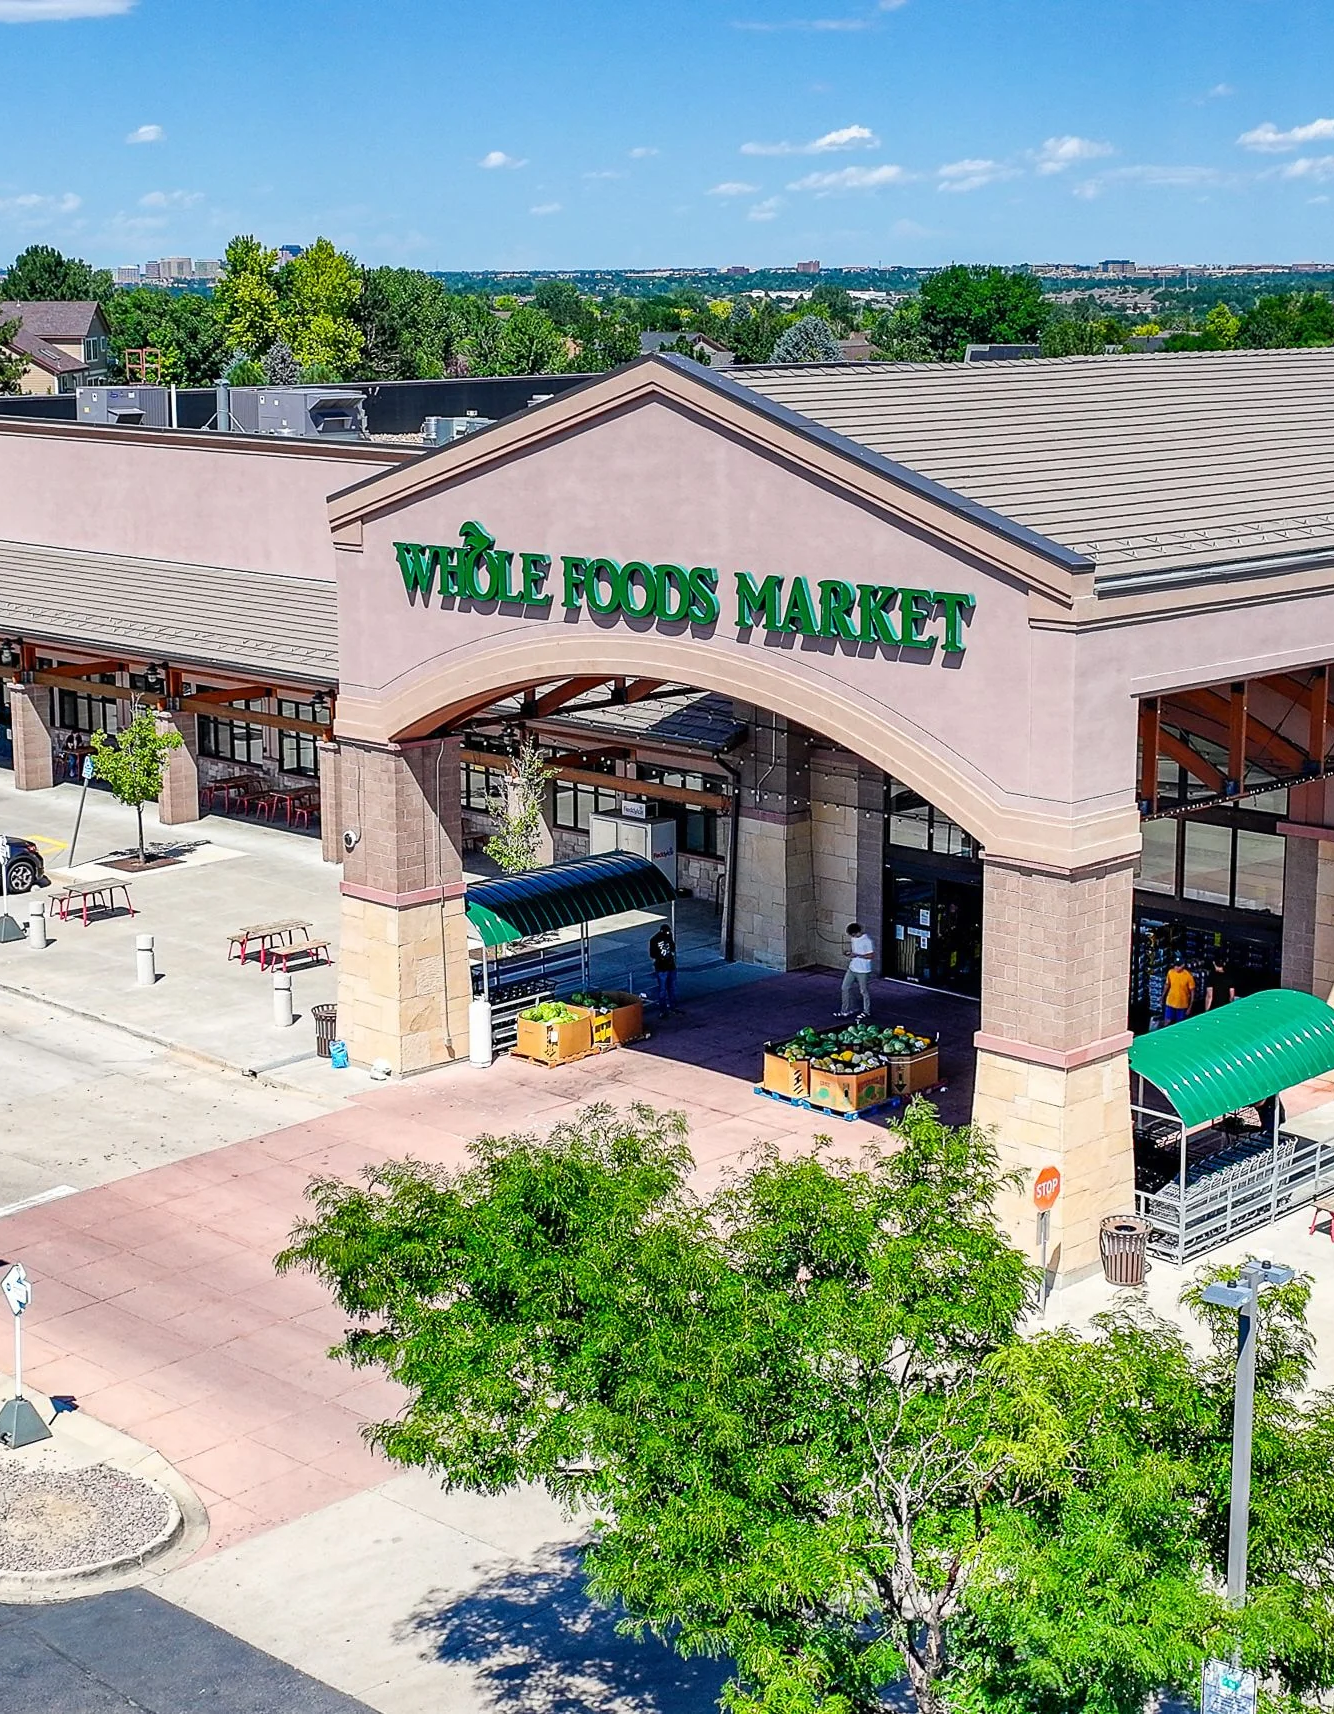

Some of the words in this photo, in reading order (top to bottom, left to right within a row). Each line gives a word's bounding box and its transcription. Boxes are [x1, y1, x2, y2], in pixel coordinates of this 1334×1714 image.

[392, 521, 553, 606] WHOLE
[560, 556, 720, 625] FOODS
[734, 571, 976, 653] MARKET
[1036, 1177, 1058, 1199] STOP
